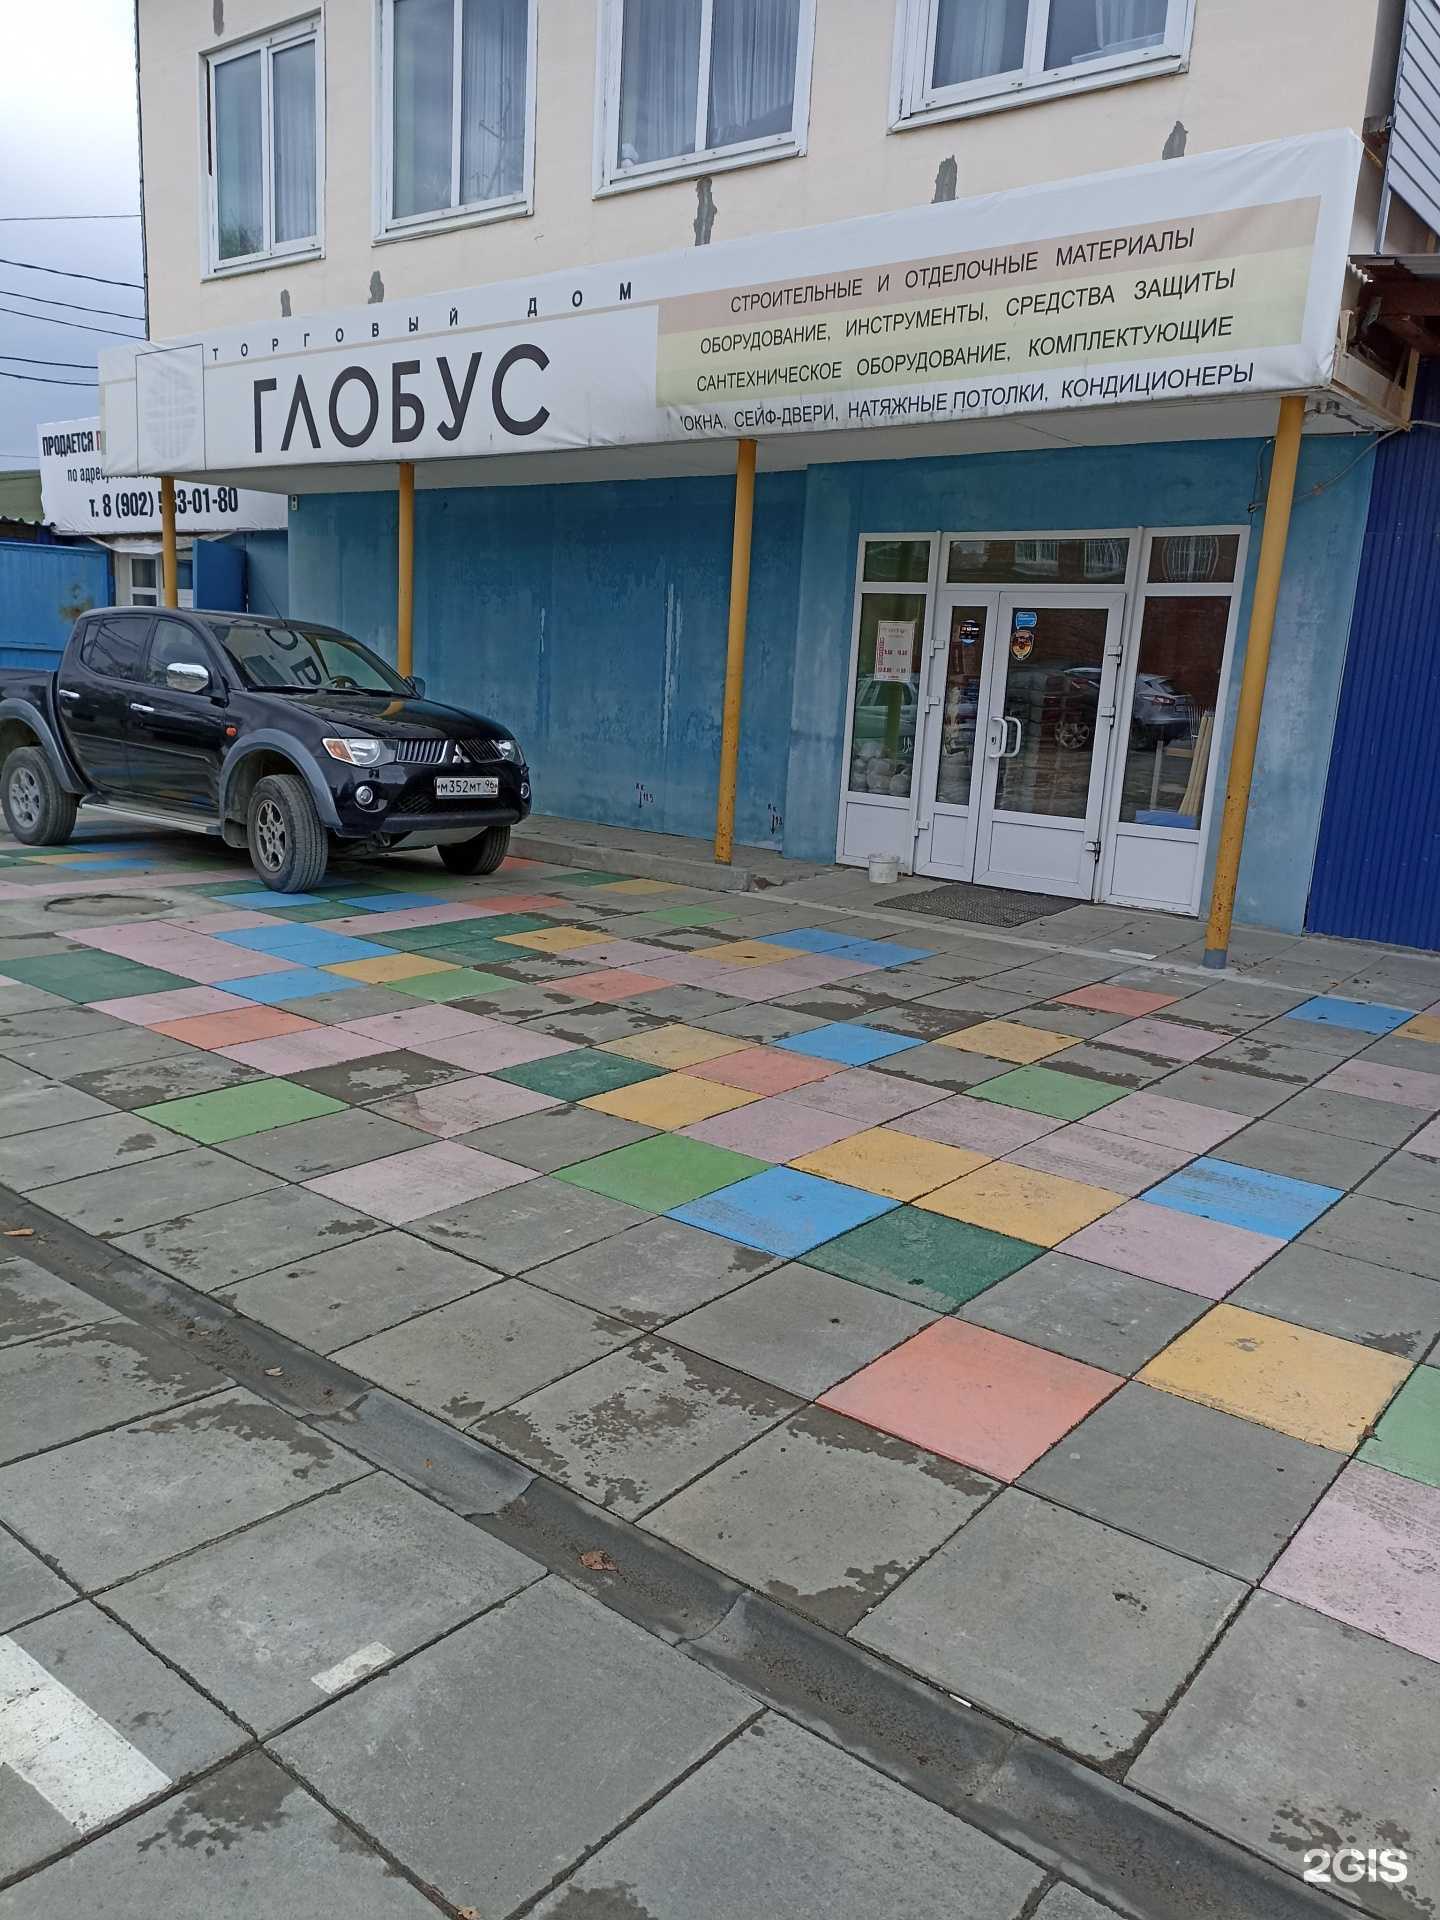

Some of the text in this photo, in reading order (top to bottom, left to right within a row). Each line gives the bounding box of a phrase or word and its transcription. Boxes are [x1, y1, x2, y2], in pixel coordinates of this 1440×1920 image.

[731, 227, 1195, 313] СТРОИТЕЛЬНЫЕ И ОТДЕЛОЧНЫЕ МАТЕРИАЛЫ
[212, 281, 632, 361] ТОРГОВЫЙ ДОМ
[700, 268, 1236, 355] ОБОРУДОВАНИЕ, ИНСТРУМЕНТЫ, СРЕДСТВА ЗАЩИТЫ
[697, 316, 1234, 392] САНТЕХНИЧЕСКОЕ ОБОРУДОВАНИЕ, КОМПЛЕКТУЮЩИЕ
[253, 343, 550, 454] ГЛОБУС
[734, 402, 839, 428] СЕЙФ-ДВЕРИ,
[848, 392, 947, 419] НАТЯЖНЫЕ
[953, 383, 1049, 410] ПОТОЛКИ,
[1061, 362, 1254, 398] КОНДИЦИОНЕРЫ
[42, 430, 94, 457] ПРОДАЕТСЯ
[67, 468, 78, 482] по
[102, 493, 112, 517] 8
[115, 491, 154, 519] (902)
[158, 486, 239, 515] 3-01-80
